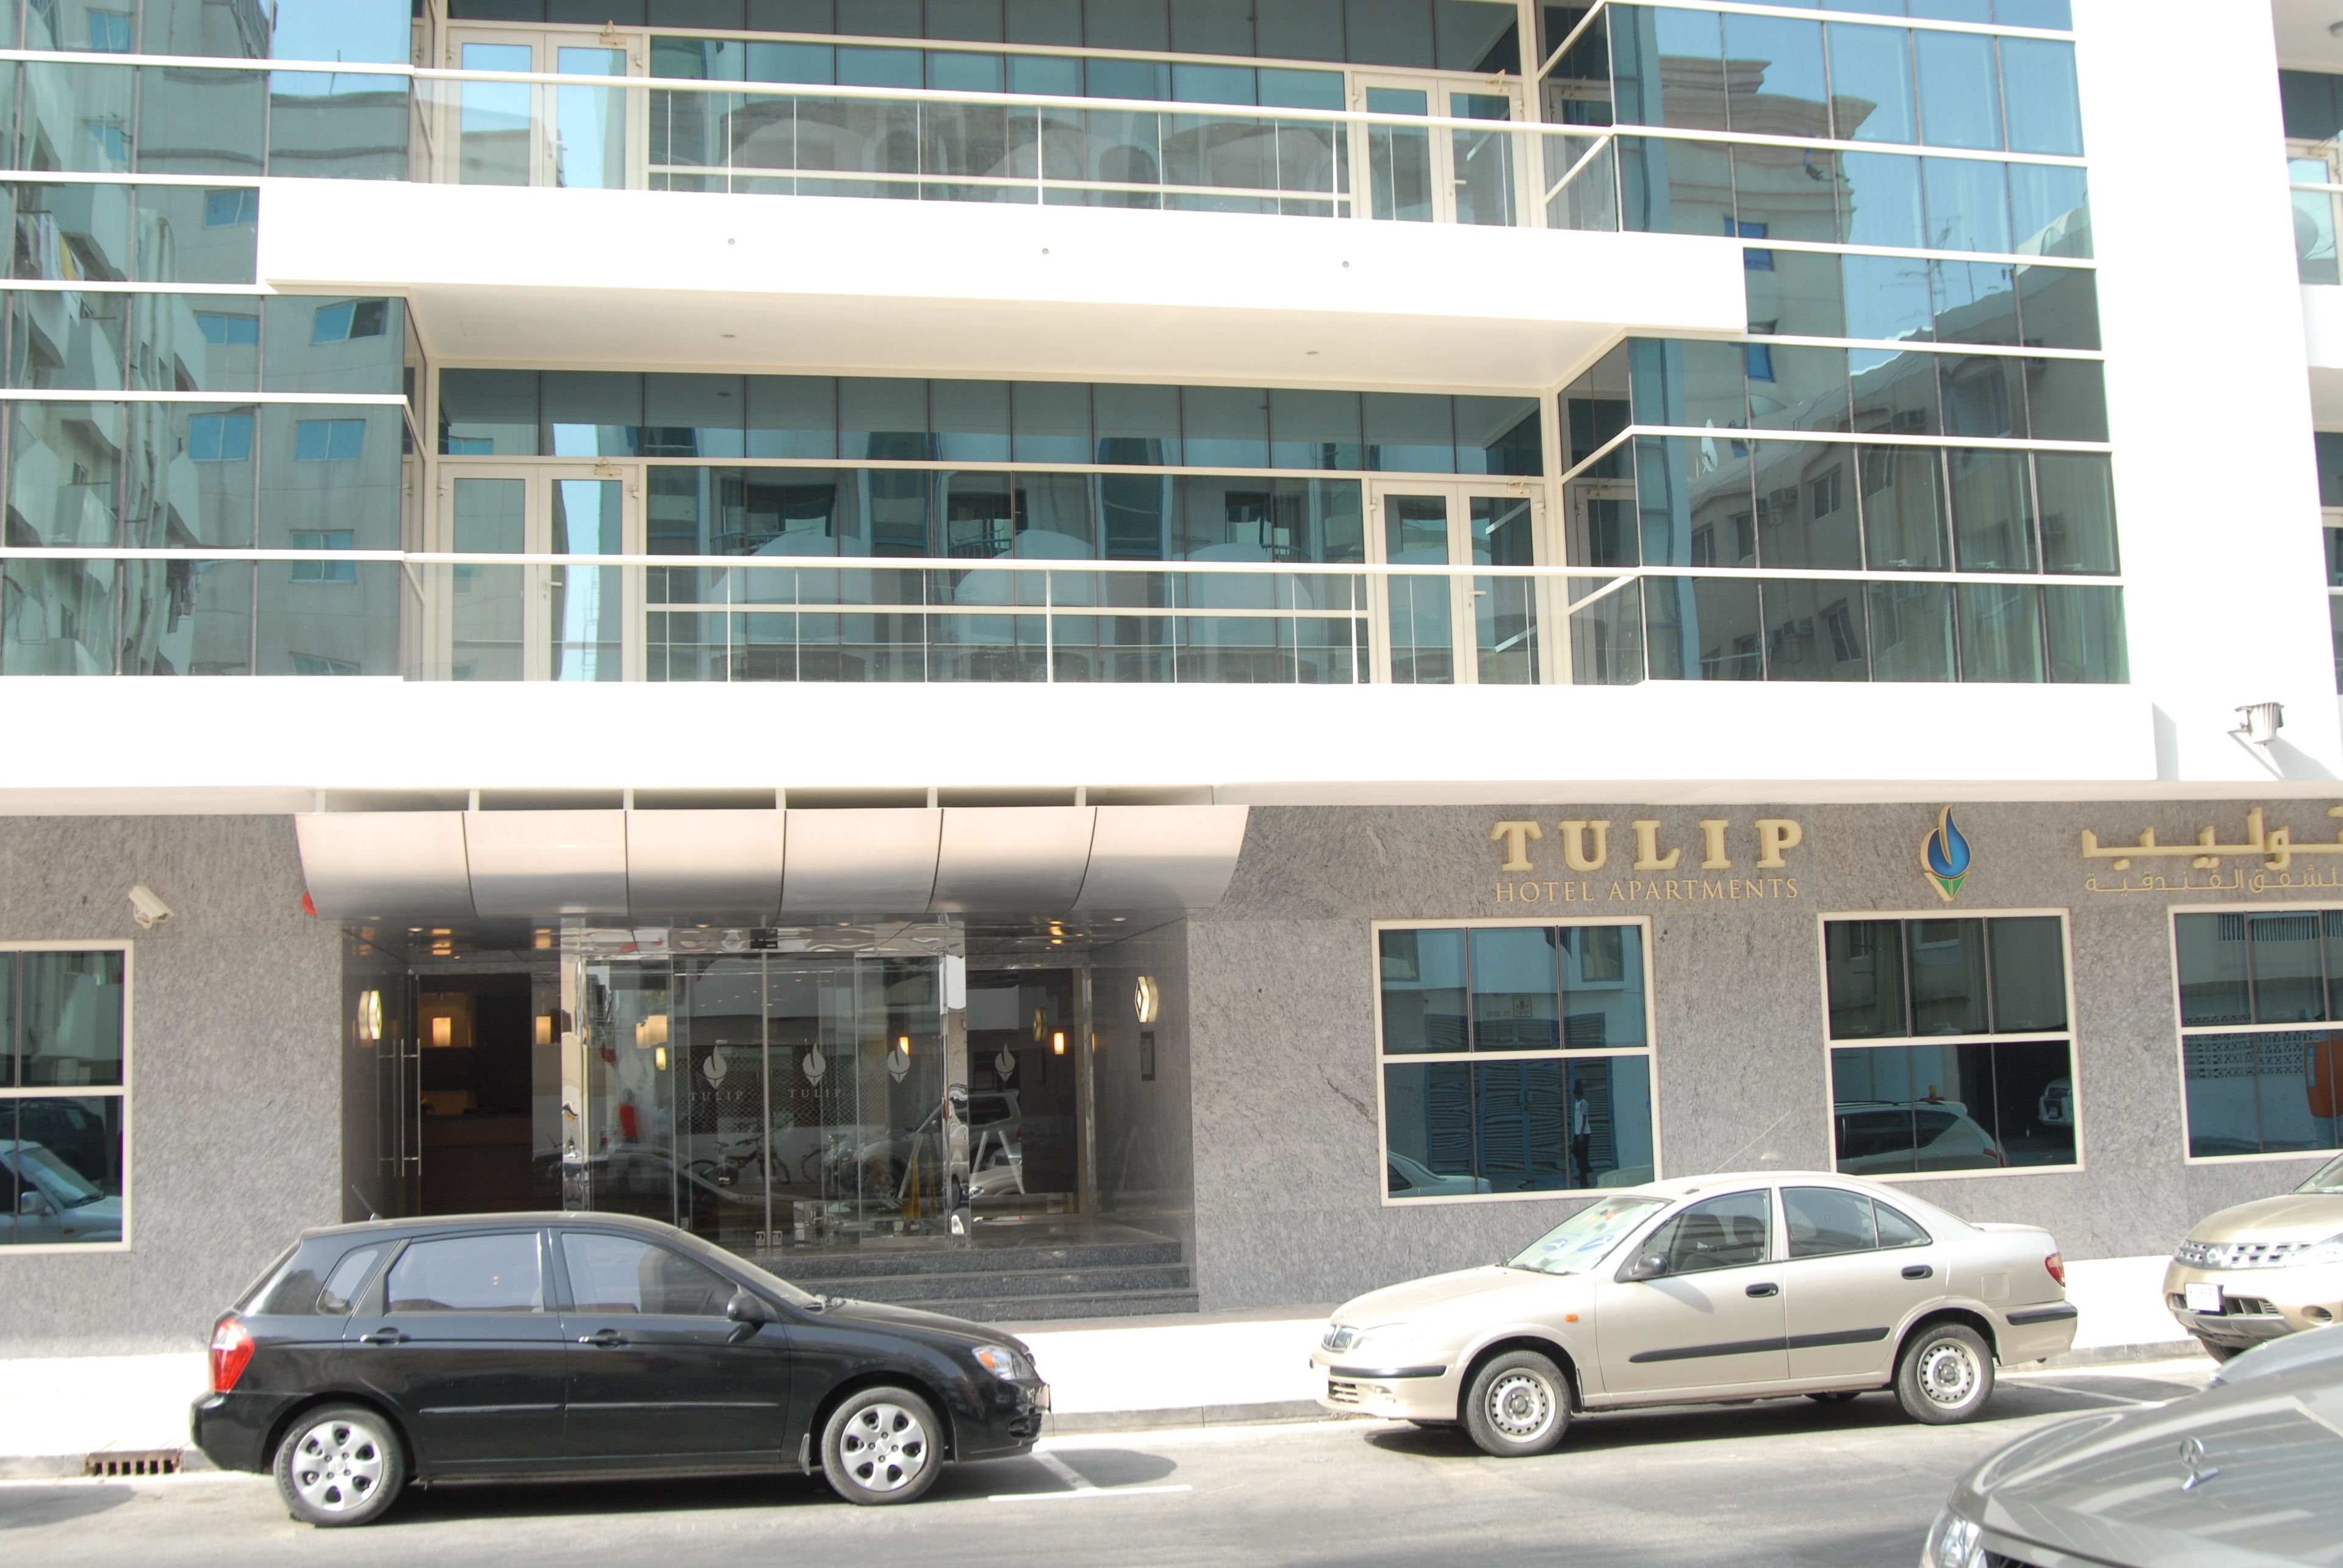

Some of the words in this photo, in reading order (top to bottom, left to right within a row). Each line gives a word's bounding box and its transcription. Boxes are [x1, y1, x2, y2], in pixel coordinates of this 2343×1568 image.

[1491, 819, 1803, 872] TULIP
[1495, 881, 1594, 902] HOTEL
[1608, 878, 1798, 901] APARTMENTS
[2086, 869, 2244, 896] الفندقية
[689, 1091, 743, 1101] TULIP
[788, 1089, 841, 1098] TULIP
